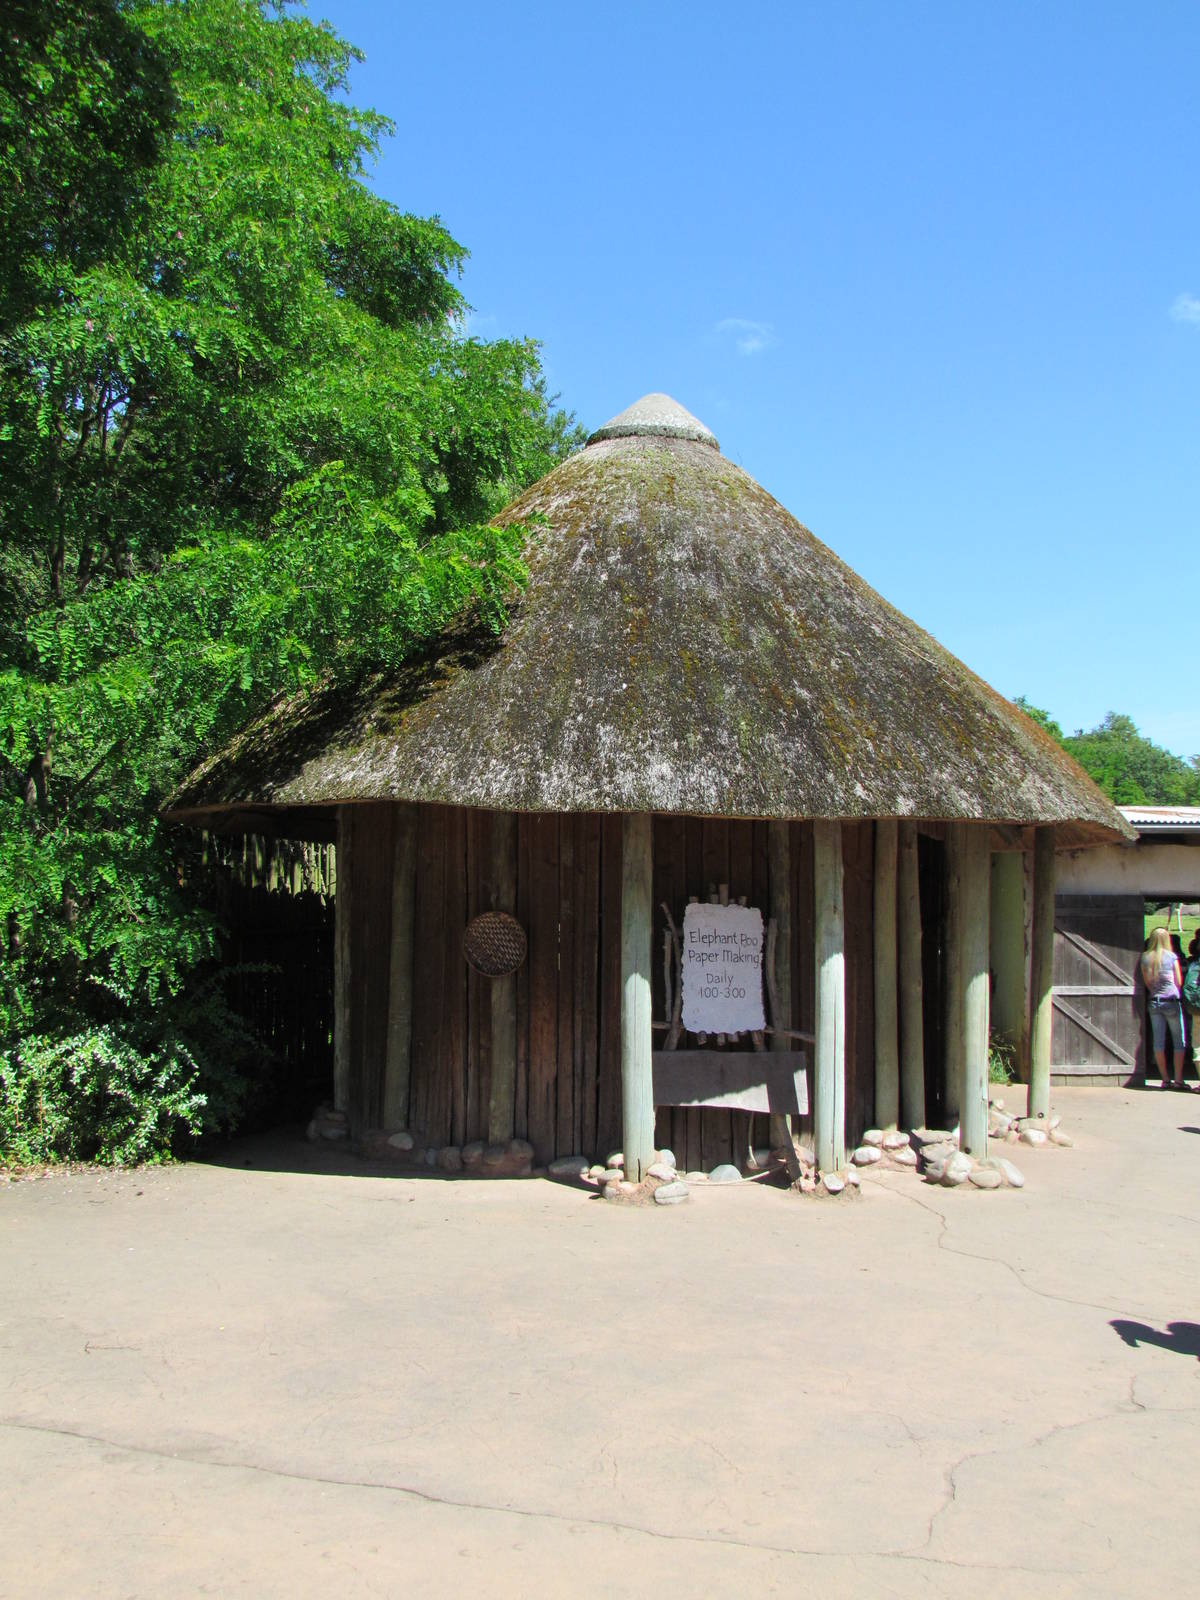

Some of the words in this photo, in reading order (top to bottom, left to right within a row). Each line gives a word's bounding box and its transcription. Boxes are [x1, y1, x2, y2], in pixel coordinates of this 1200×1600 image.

[689, 928, 738, 947] Elephant
[740, 933, 758, 946] Poo
[688, 949, 719, 967] Paper
[722, 947, 760, 969] Making
[706, 969, 734, 987] Daily
